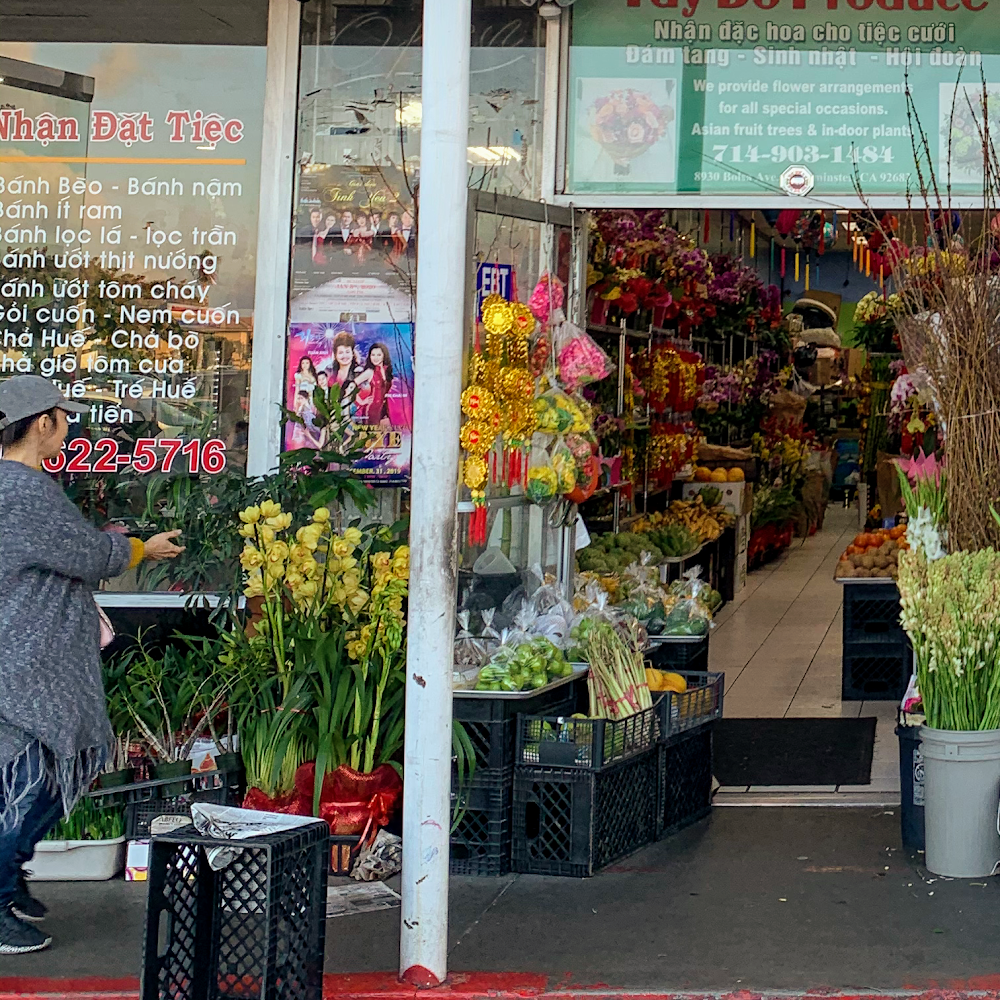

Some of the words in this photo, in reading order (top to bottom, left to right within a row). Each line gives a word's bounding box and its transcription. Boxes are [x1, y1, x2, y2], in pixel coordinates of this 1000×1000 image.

[654, 20, 712, 43] Nhận
[766, 21, 805, 42] hoa
[812, 22, 852, 42] cho
[858, 22, 901, 44] tiệc
[907, 22, 956, 43] cưới
[625, 45, 676, 65] Đám
[683, 46, 729, 68] tang
[753, 46, 801, 66] Sinh
[808, 46, 857, 68] nhật
[693, 79, 714, 92] We
[718, 79, 768, 95] provide
[773, 79, 815, 93] flower
[819, 81, 914, 96] arrangements
[718, 101, 738, 114] for
[741, 101, 758, 114] all
[762, 102, 811, 117] special
[815, 103, 888, 115] occasions.
[90, 109, 154, 148] Đặt
[165, 108, 245, 149] Tiệc
[691, 122, 730, 136] Asian
[734, 123, 763, 136] fruit
[767, 124, 802, 136] trees
[807, 123, 817, 136] &
[821, 123, 869, 137] in-door
[872, 124, 913, 139] plants
[711, 144, 895, 164] 714-903-1484
[58, 176, 103, 195] Bèo
[127, 176, 184, 196] Bánh
[693, 171, 720, 182] 8930
[860, 173, 877, 183] CA
[57, 195, 71, 219] ít
[79, 204, 122, 219] ram
[0, 223, 47, 243] ánh
[55, 225, 92, 247] lọc
[100, 224, 122, 244] lá
[146, 226, 183, 248] lọc
[2, 247, 46, 269] ánh
[100, 250, 135, 272] thịt
[1, 277, 44, 298] ánh
[98, 280, 142, 299] tôm
[0, 301, 28, 323] ỏi
[36, 301, 95, 323] cuốn
[120, 304, 172, 324] Nem
[0, 326, 34, 348] hả
[41, 326, 93, 348] Huế
[111, 327, 160, 349] Chả
[1, 351, 32, 373] hả
[87, 354, 131, 374] tôm
[138, 359, 184, 374] cua
[53, 377, 92, 398] uế
[112, 378, 146, 399] Tré
[152, 376, 198, 399] Huế
